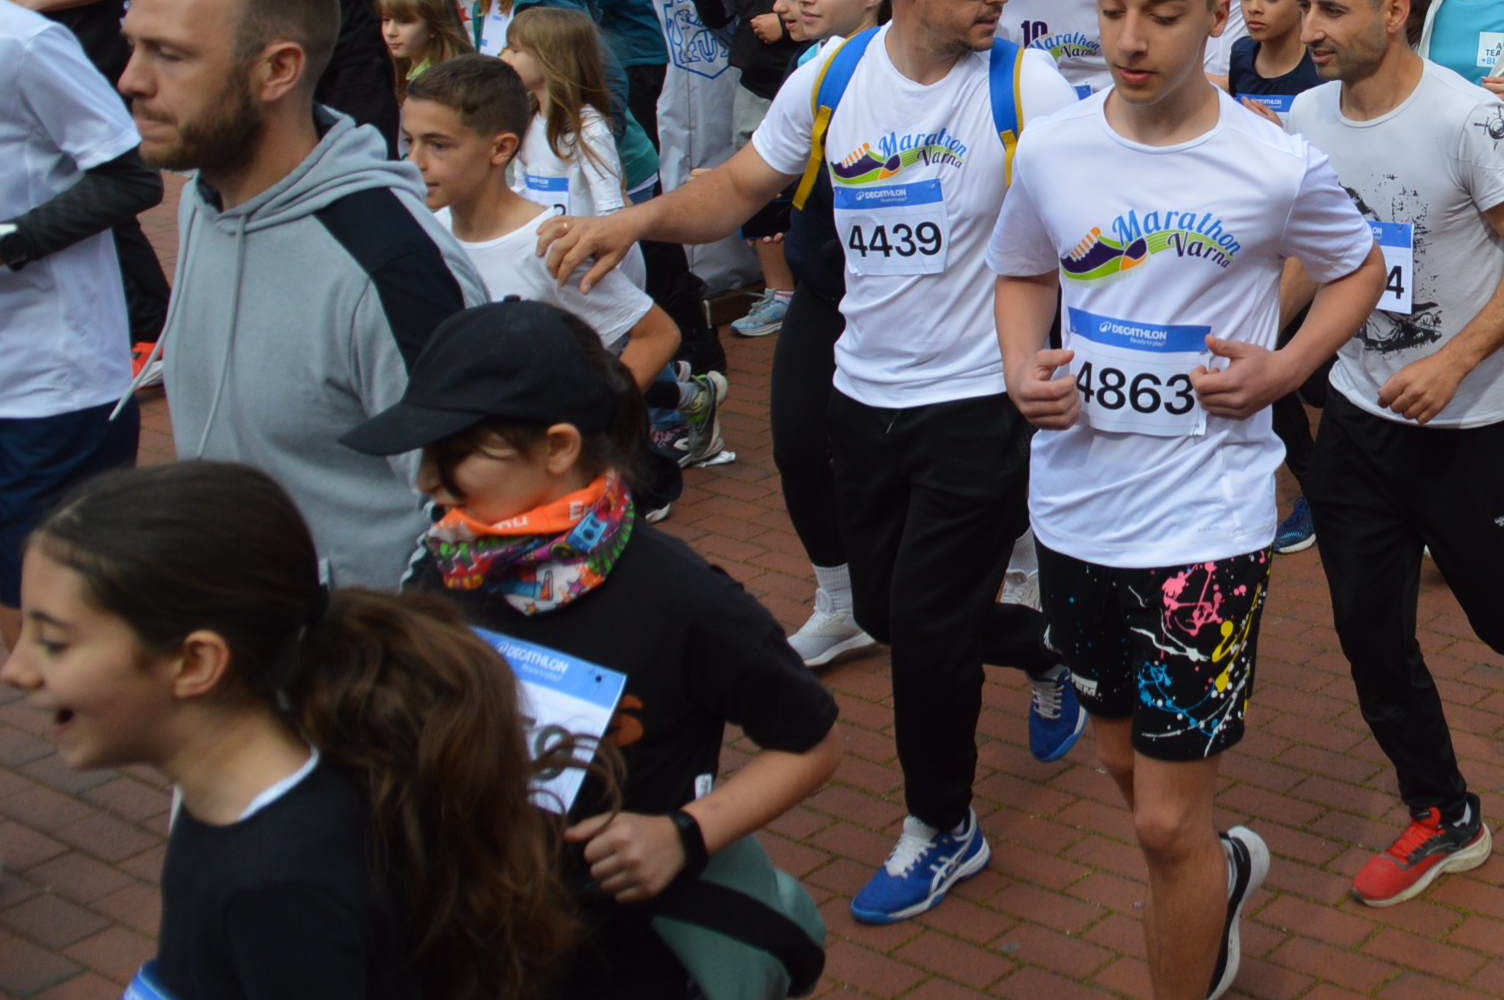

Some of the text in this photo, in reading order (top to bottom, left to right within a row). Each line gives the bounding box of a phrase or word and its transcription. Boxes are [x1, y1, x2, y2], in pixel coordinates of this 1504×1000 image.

[1021, 20, 1048, 49] 10
[917, 148, 963, 169] Varna
[864, 188, 907, 200] DECATHLON
[848, 221, 943, 258] 4439
[1112, 208, 1242, 256] Marathon
[1167, 231, 1232, 269] Varna
[1111, 323, 1167, 341] DECATHLON
[1076, 360, 1196, 416] 4863
[507, 644, 569, 674] DECATHLON
